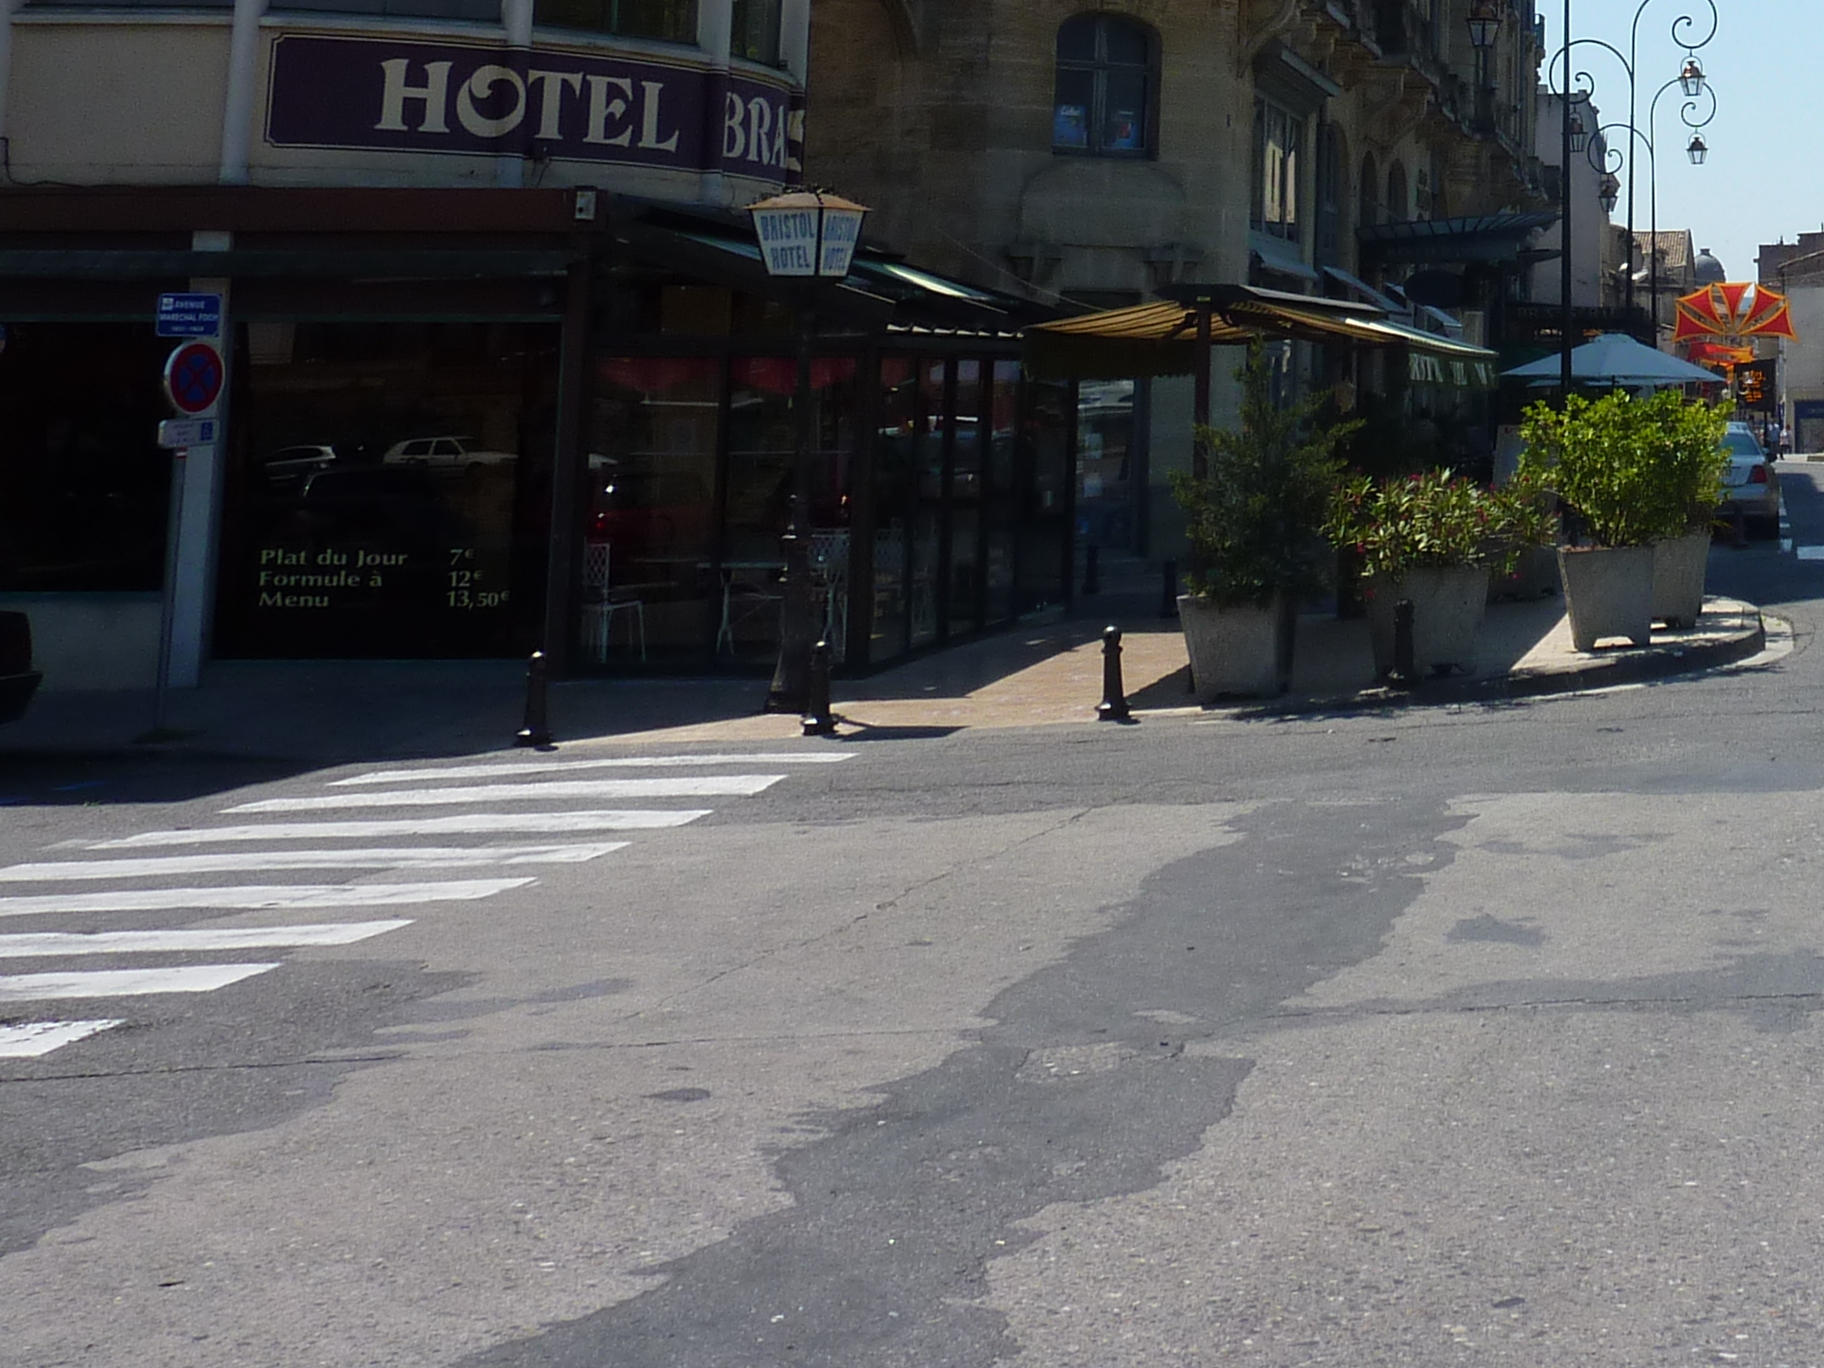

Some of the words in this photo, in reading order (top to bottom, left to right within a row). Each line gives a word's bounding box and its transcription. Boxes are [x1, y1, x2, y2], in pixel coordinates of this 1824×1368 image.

[374, 57, 680, 153] HOTEL
[760, 212, 815, 241] BRISTOL
[771, 244, 811, 269] HOTEL
[175, 300, 205, 309] AVENUE
[259, 548, 308, 566] Plat
[316, 548, 347, 566] du
[356, 549, 408, 568] Jour
[258, 570, 361, 588] Formule
[369, 570, 383, 587] à
[448, 570, 483, 588] 12€
[257, 591, 331, 608] Menu
